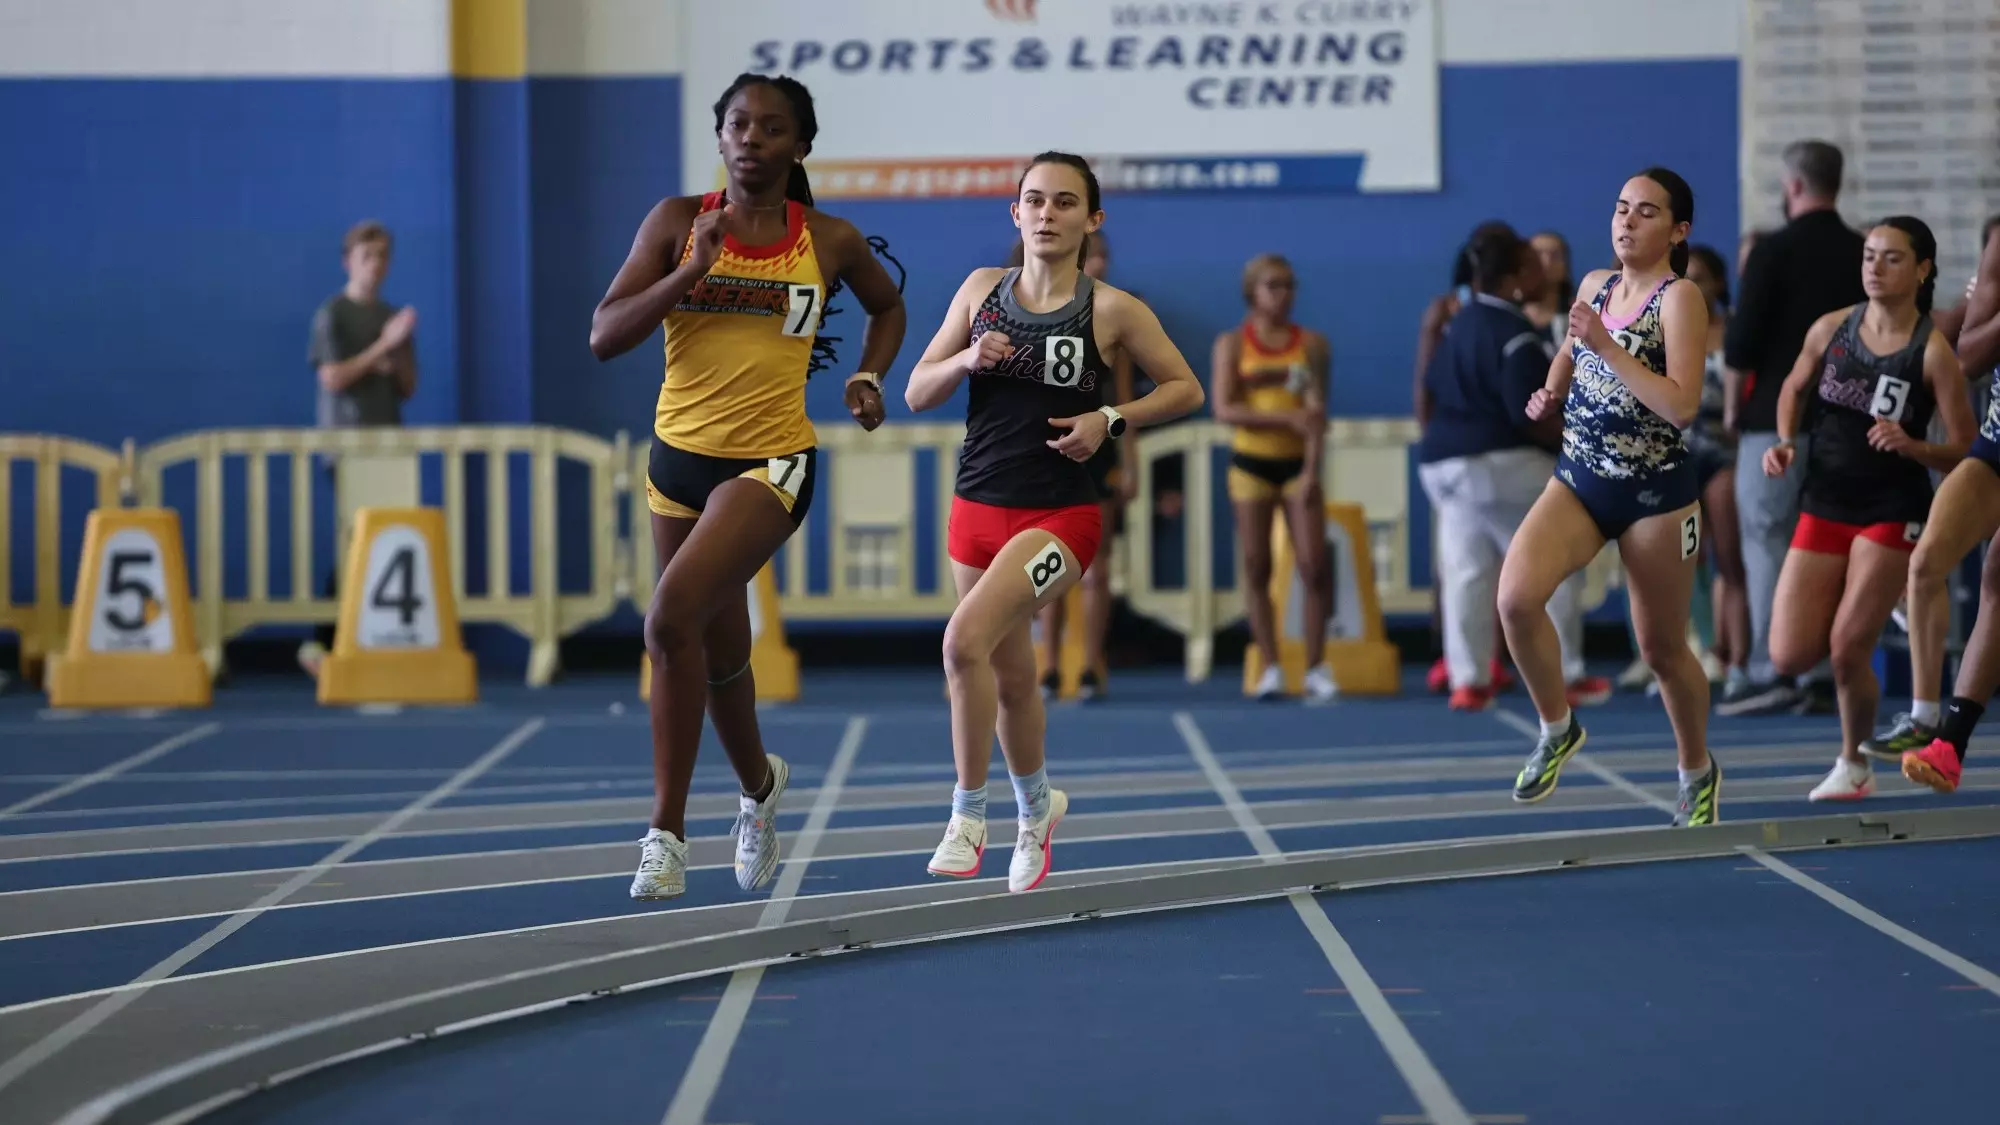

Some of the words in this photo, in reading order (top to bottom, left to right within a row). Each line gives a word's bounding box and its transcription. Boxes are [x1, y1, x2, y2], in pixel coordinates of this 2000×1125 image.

[1110, 1, 1244, 28] WAYNE
[1293, 0, 1419, 26] CURRY
[750, 37, 995, 73] SPORTS
[1010, 37, 1050, 73] &
[1066, 30, 1407, 71] LEARNING
[1186, 74, 1395, 109] CENTER
[705, 275, 772, 289] UNIVERSITY
[792, 288, 815, 334] 7
[1052, 338, 1077, 385] 8
[1878, 381, 1903, 416] 5
[776, 455, 800, 488] 7
[1685, 516, 1698, 556] 3
[371, 547, 424, 625] 4
[1032, 551, 1062, 588] 8
[104, 551, 156, 632] 5
